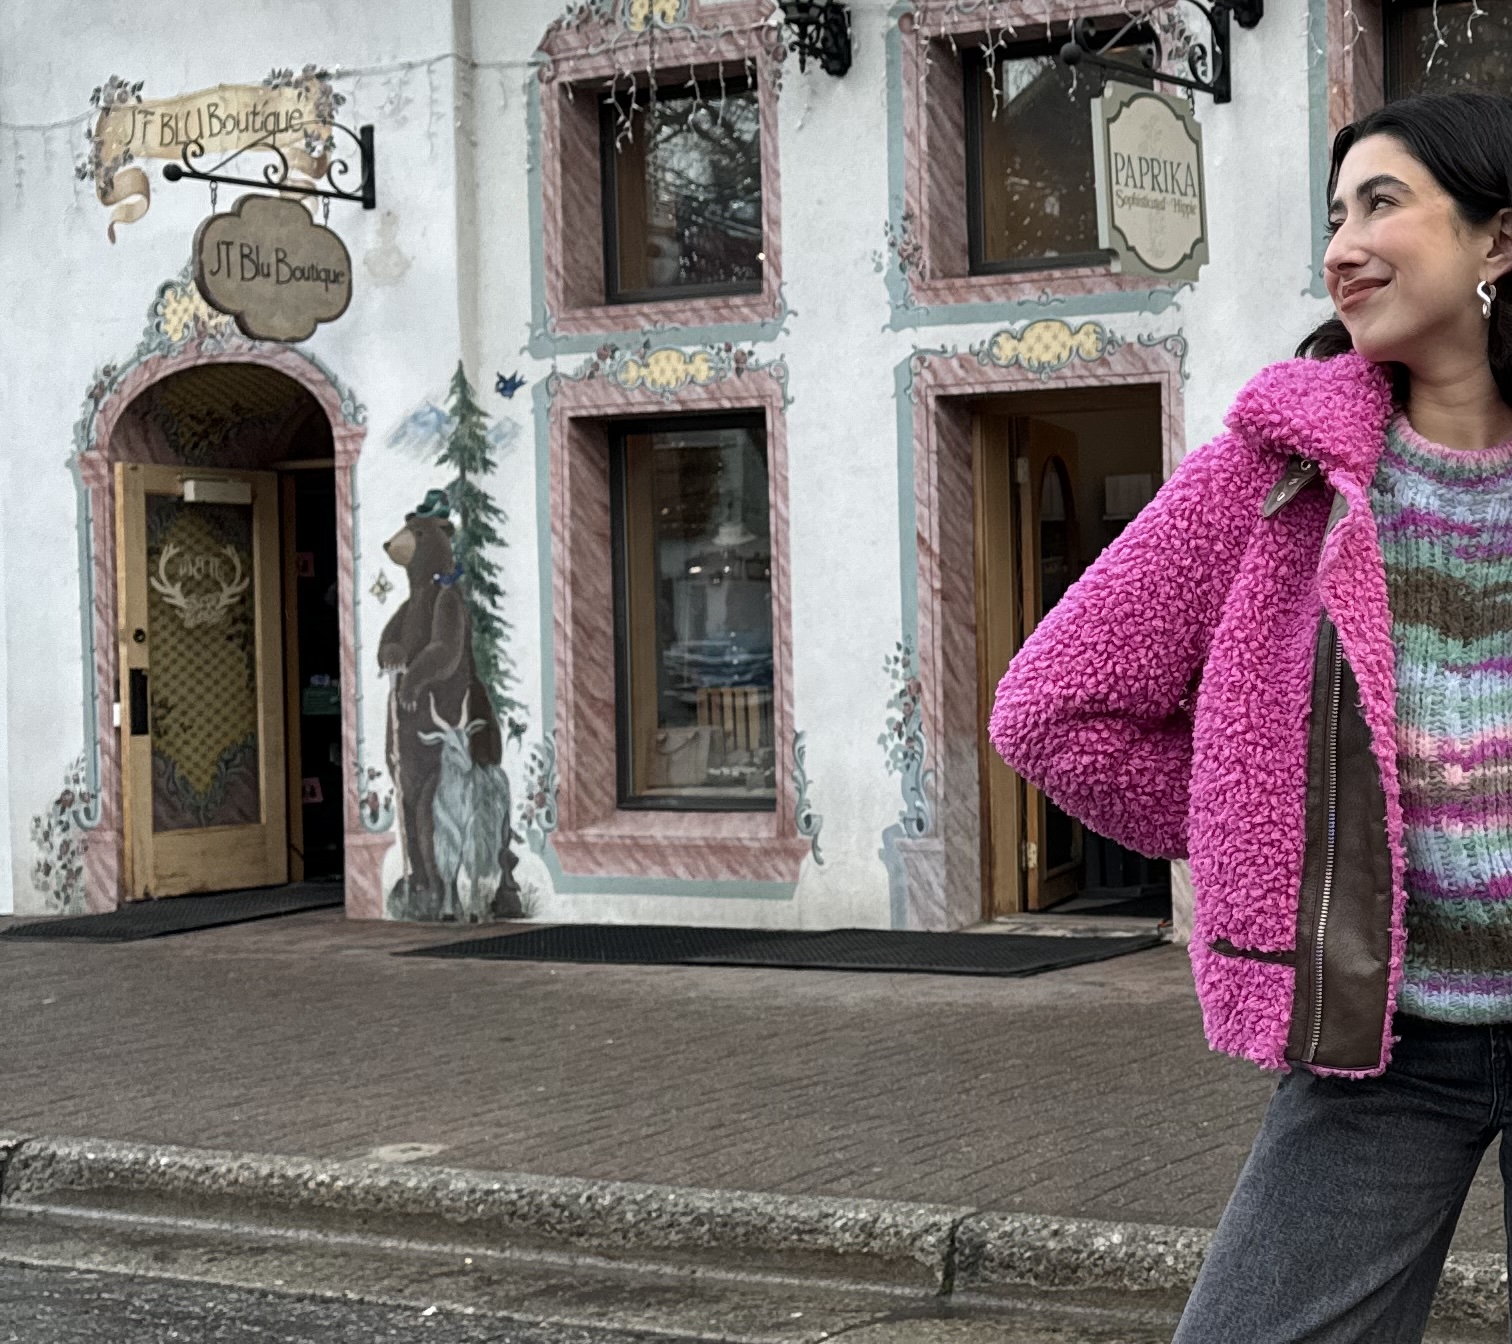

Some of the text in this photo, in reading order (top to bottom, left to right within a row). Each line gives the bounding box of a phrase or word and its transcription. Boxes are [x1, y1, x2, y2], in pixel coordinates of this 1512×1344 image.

[126, 101, 304, 146] JT BLU Boutique
[1114, 152, 1198, 198] PAPRIKA
[209, 240, 345, 292] JT Blu Boutique
